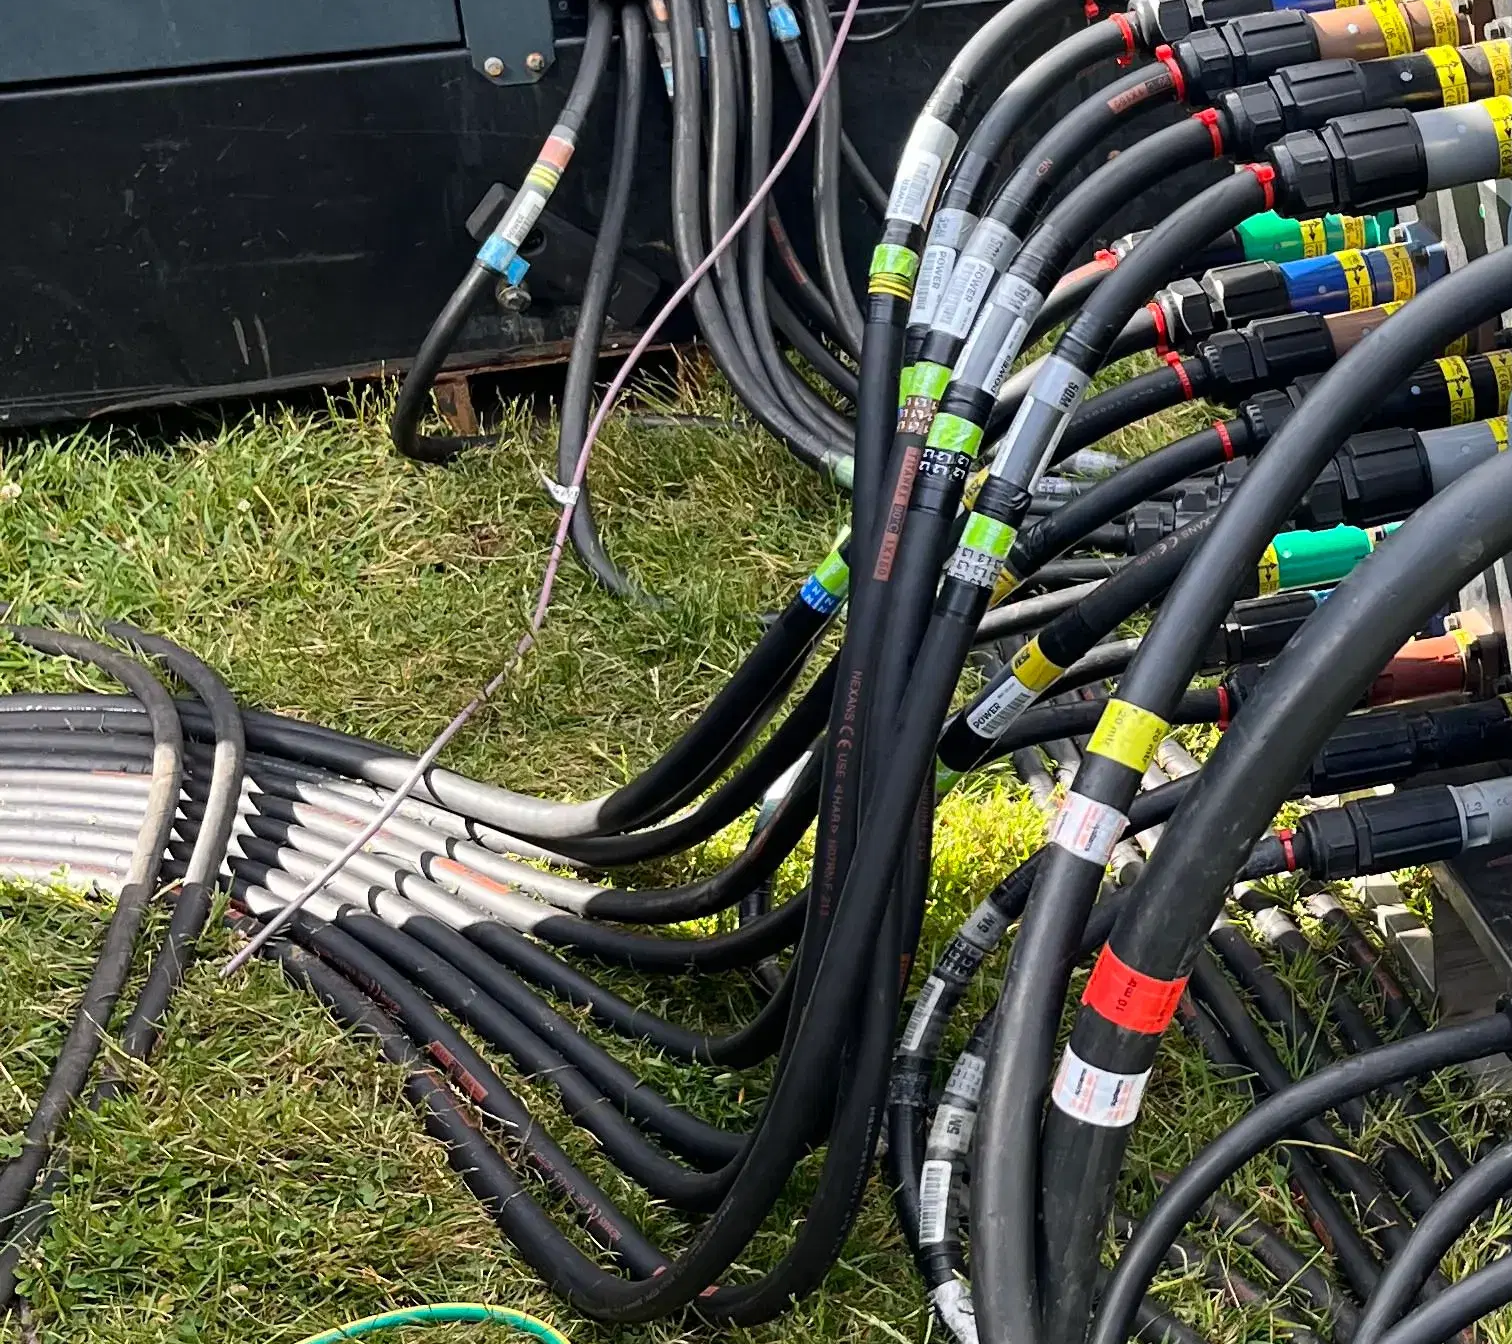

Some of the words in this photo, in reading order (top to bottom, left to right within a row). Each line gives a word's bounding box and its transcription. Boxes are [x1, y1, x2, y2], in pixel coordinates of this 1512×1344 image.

[931, 251, 947, 290] POWER
[963, 263, 987, 303] POWER
[844, 670, 863, 720] NEXANS
[973, 703, 1000, 728] POWER
[835, 753, 847, 778] USE
[977, 912, 996, 933] 5M
[1115, 997, 1128, 1011] 10
